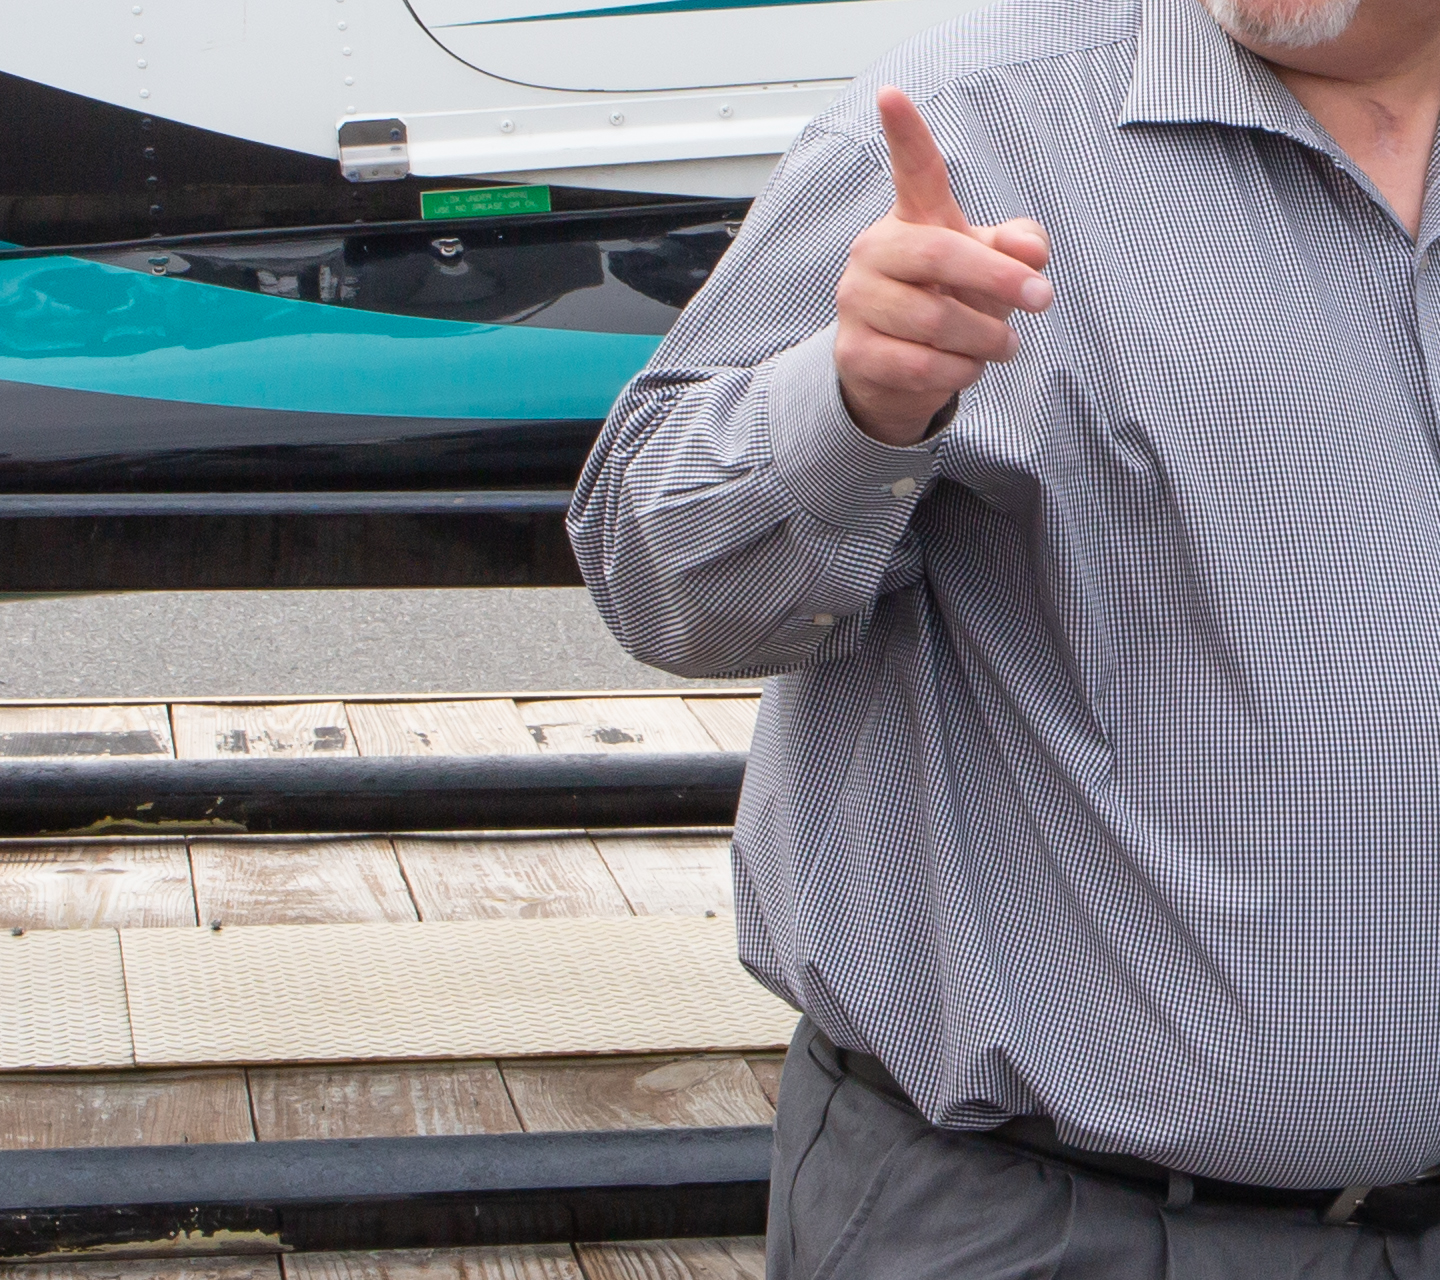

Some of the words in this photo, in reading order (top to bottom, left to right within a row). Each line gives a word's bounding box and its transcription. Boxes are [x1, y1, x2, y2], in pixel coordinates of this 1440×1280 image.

[466, 193, 492, 202] UNDER
[434, 205, 449, 214] USE
[455, 204, 466, 212] NO
[472, 202, 503, 211] GREASE
